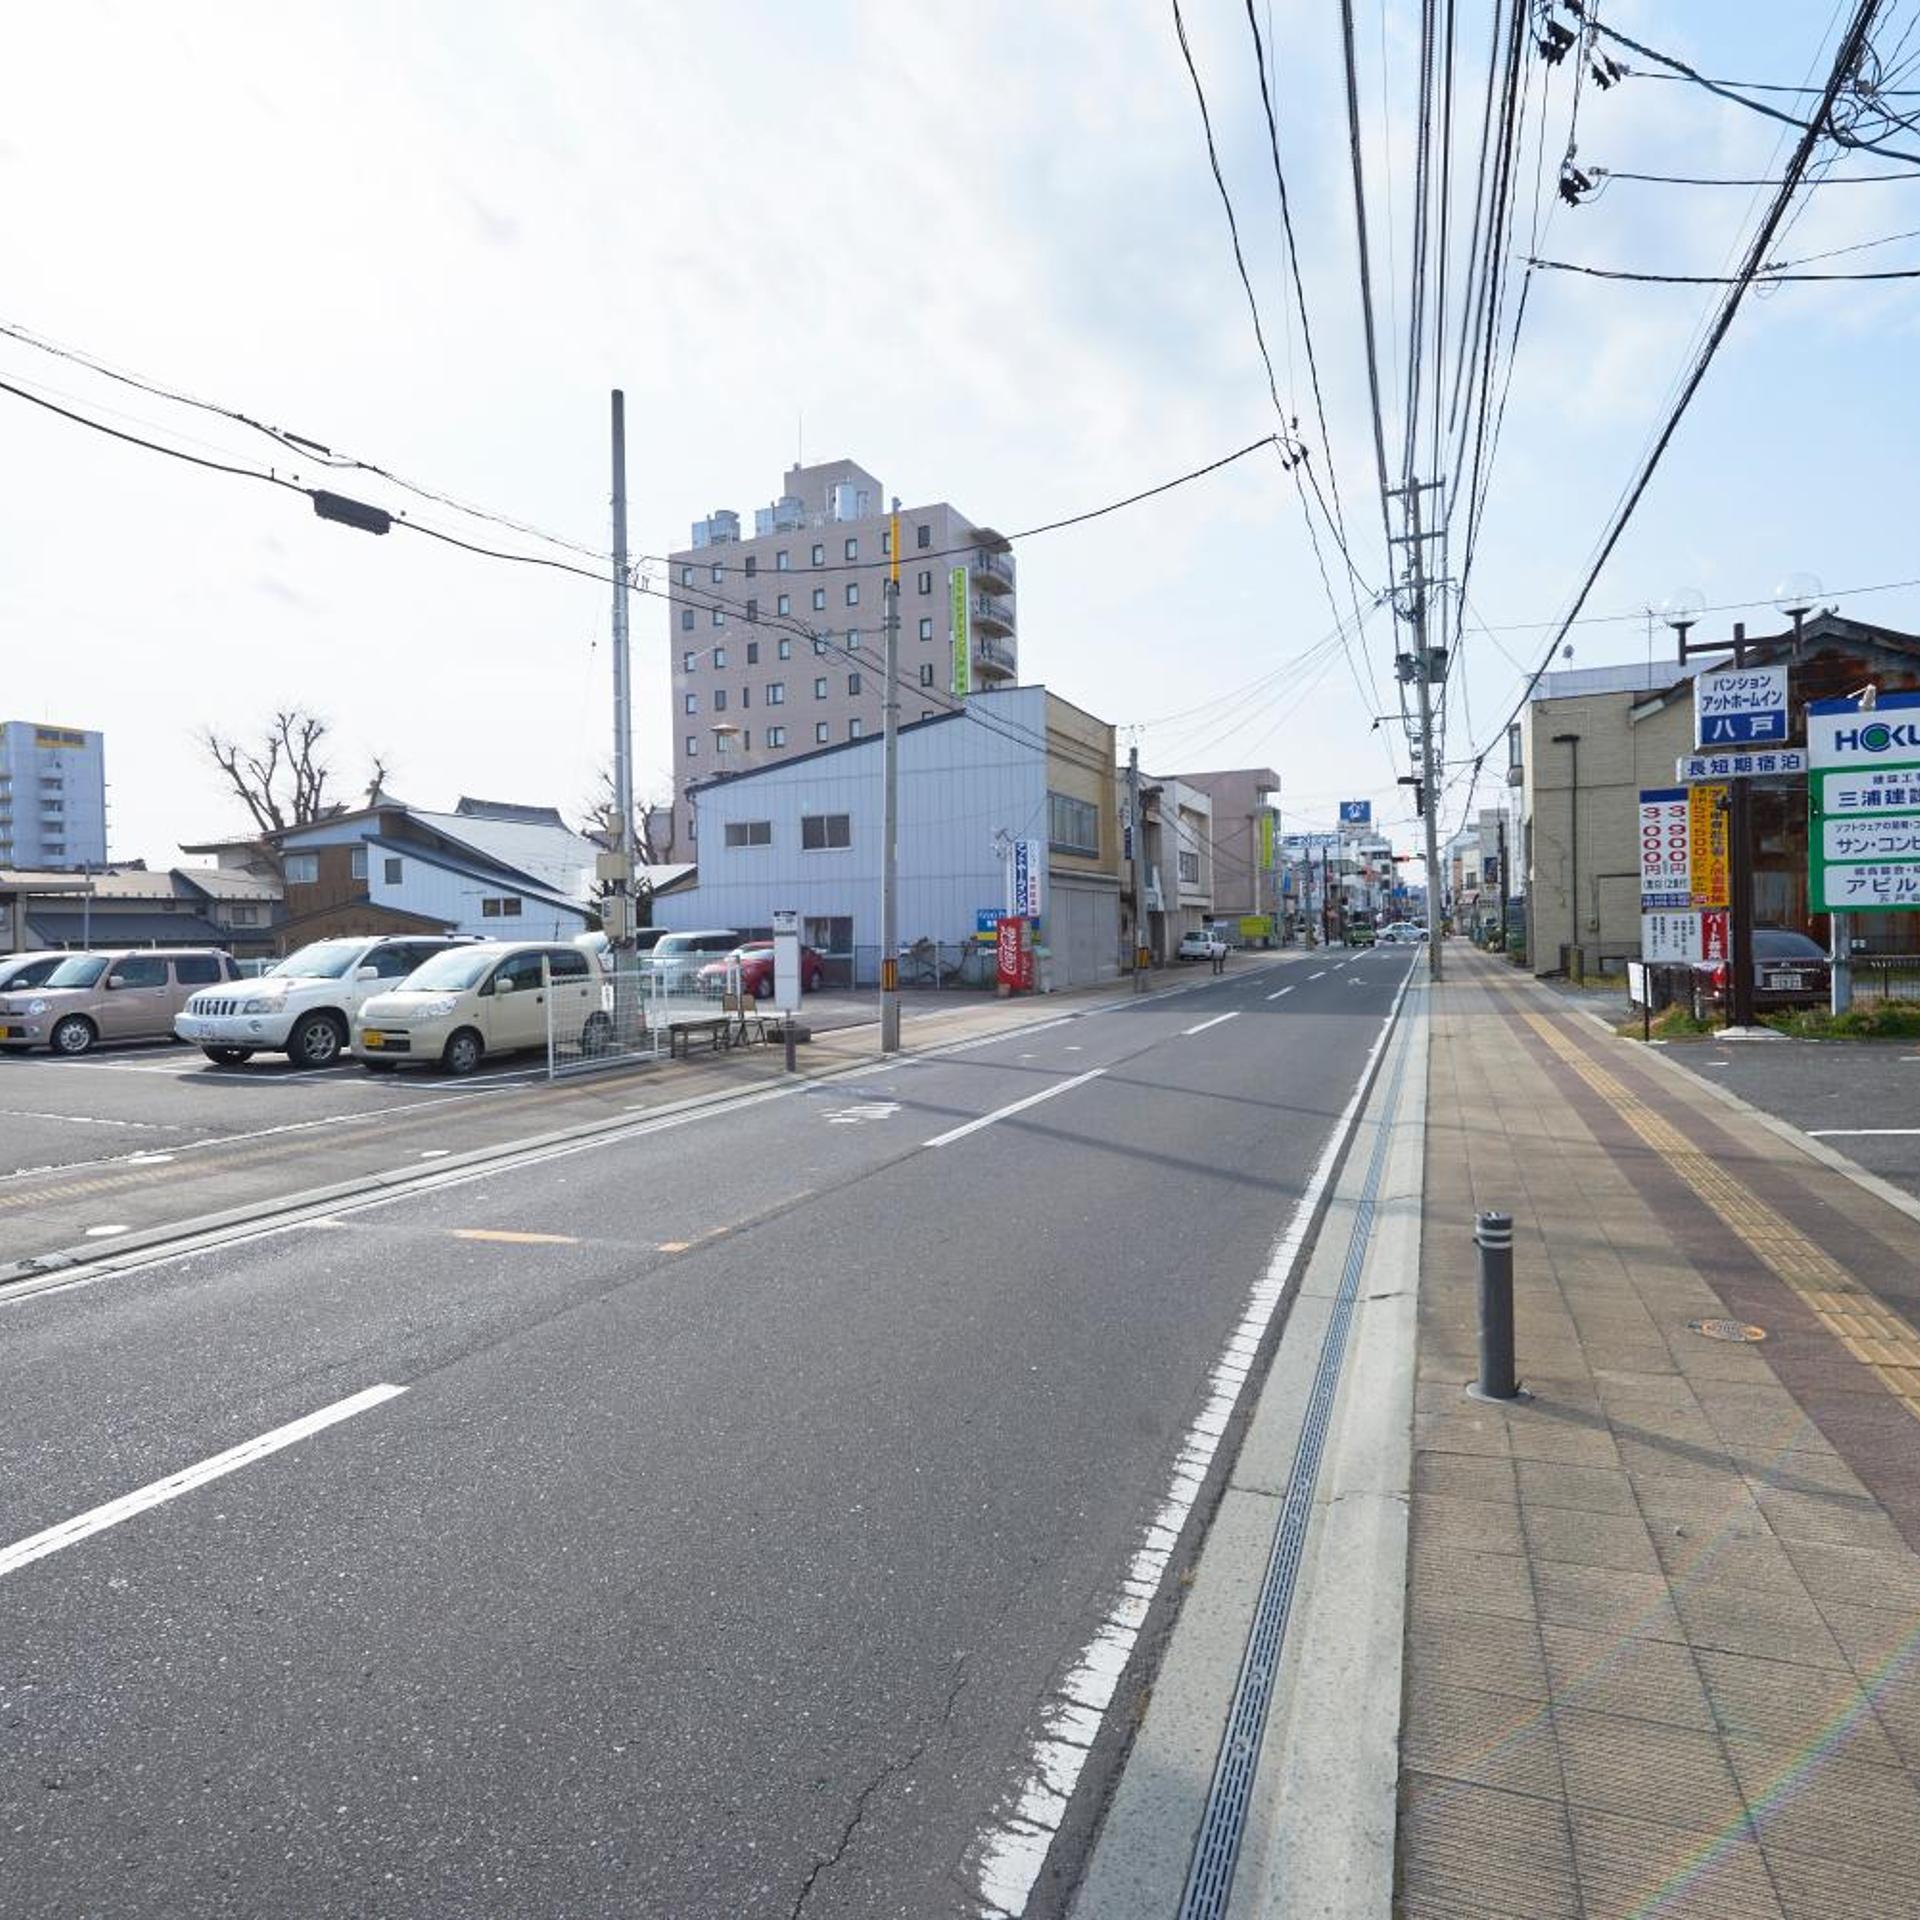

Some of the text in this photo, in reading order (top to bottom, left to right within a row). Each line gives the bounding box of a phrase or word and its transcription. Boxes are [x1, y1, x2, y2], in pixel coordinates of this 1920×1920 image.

[1702, 690, 1782, 712] アットホームイン
[1712, 716, 1774, 739] 八戸
[1687, 755, 1800, 776] 長短期宿泊
